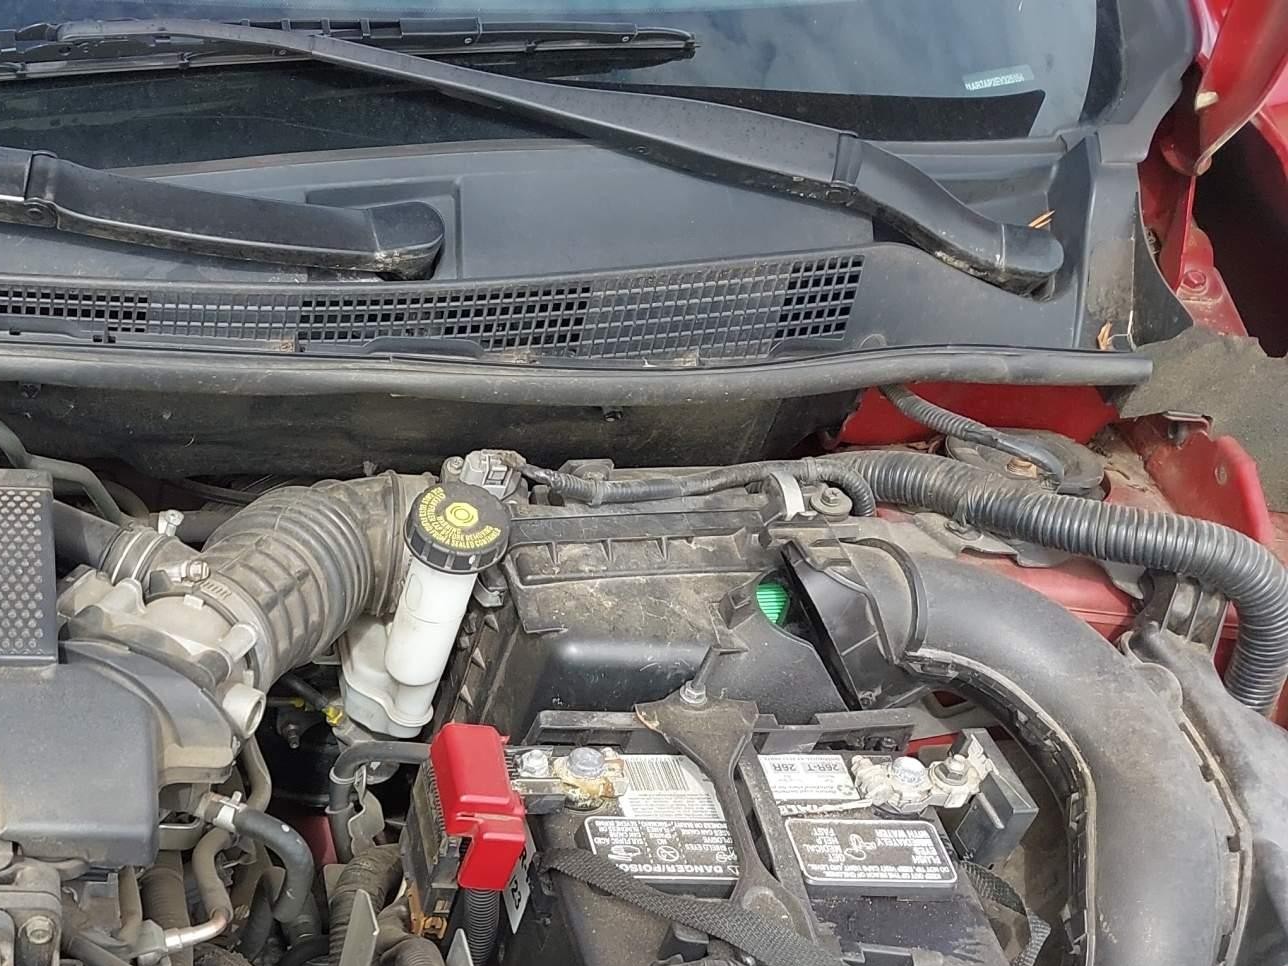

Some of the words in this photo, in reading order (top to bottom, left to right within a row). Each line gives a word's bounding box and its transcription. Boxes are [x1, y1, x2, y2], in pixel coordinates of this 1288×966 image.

[813, 827, 834, 836] FAST
[874, 830, 908, 839] WATER
[905, 830, 931, 839] WITH
[816, 836, 840, 845] HELP
[803, 844, 842, 854] MEDICAL
[828, 853, 845, 862] GET
[911, 855, 942, 865] FLUSH
[616, 864, 724, 873] DANGER/POISO
